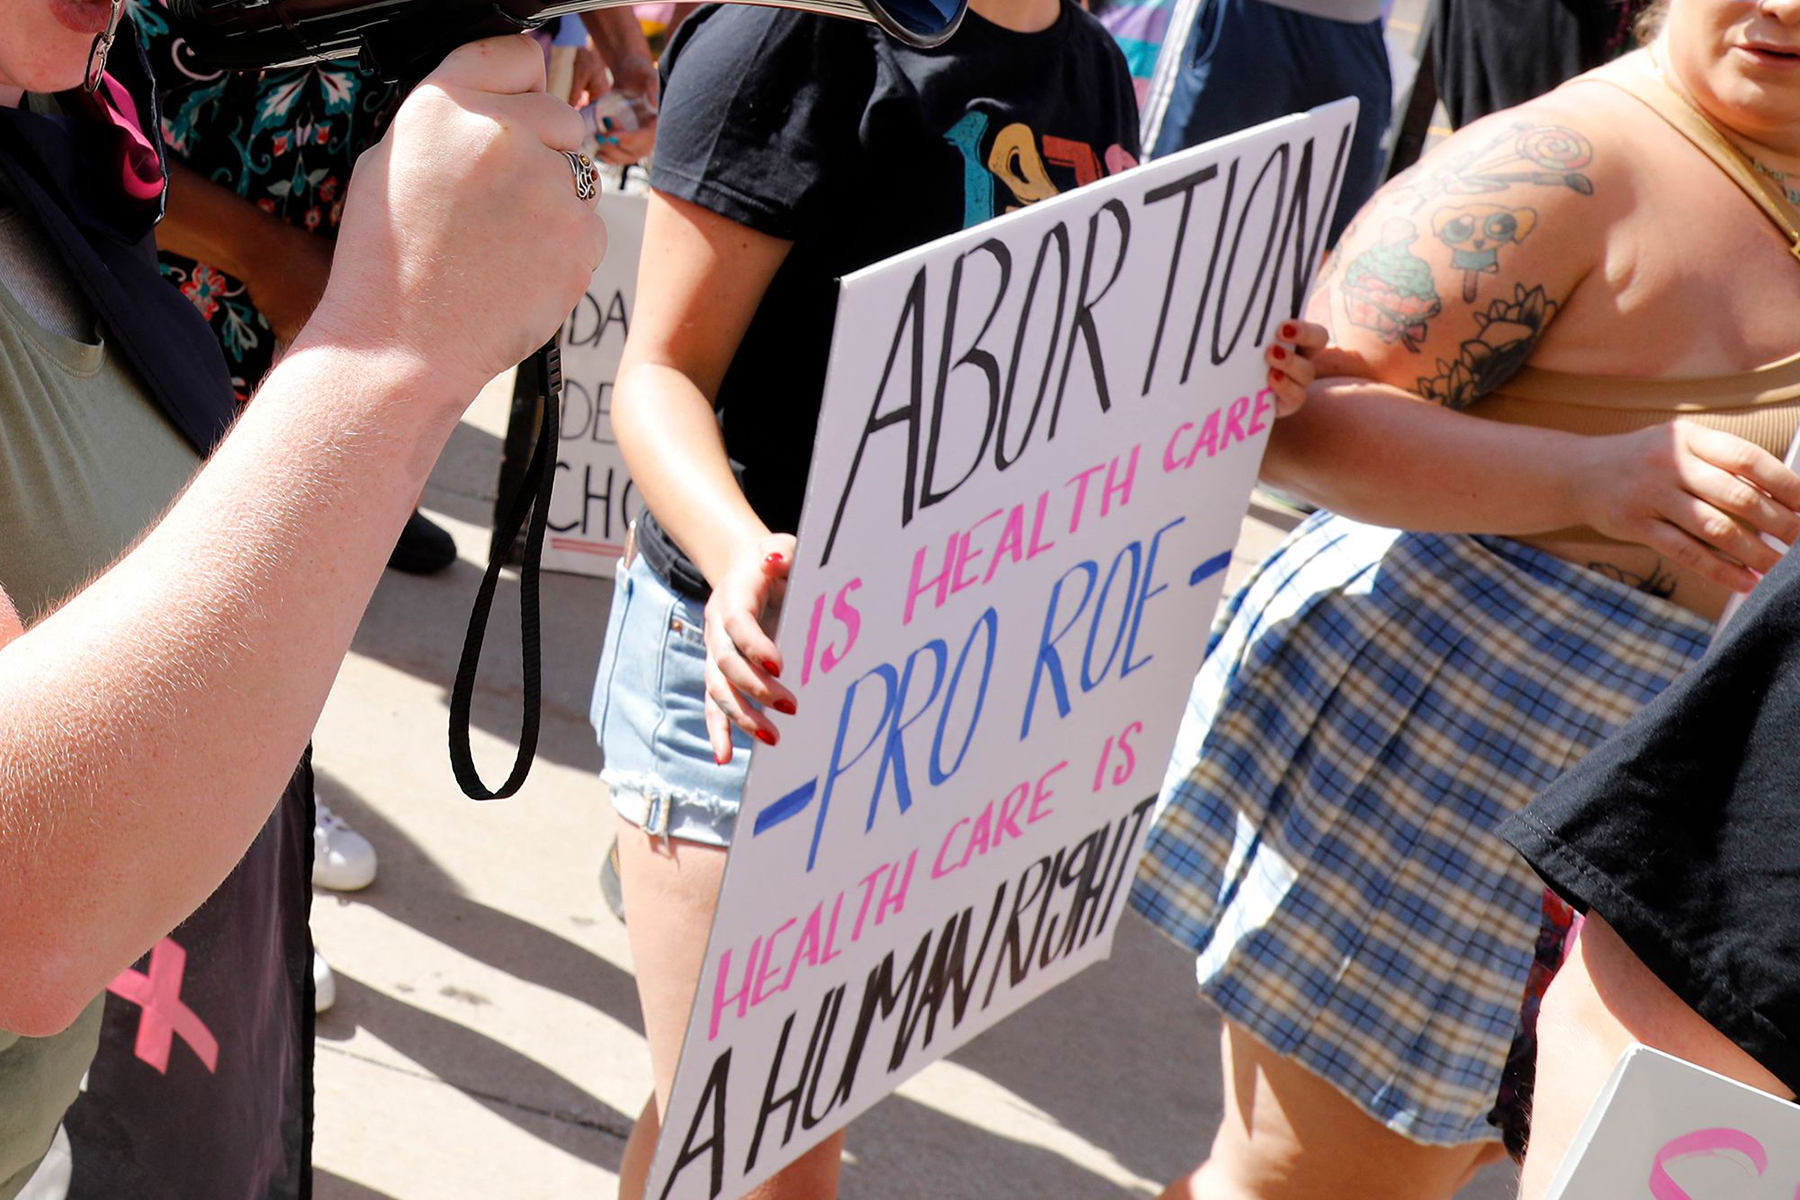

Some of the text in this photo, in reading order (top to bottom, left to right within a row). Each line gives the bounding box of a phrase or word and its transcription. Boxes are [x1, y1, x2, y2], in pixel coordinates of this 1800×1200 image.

[819, 123, 1351, 569] ABORTION
[800, 387, 1274, 688] IS HEALTH CARE
[658, 792, 1161, 1200] A HUMAN RIGHT
[708, 721, 1143, 1042] HEALTH CARE IS
